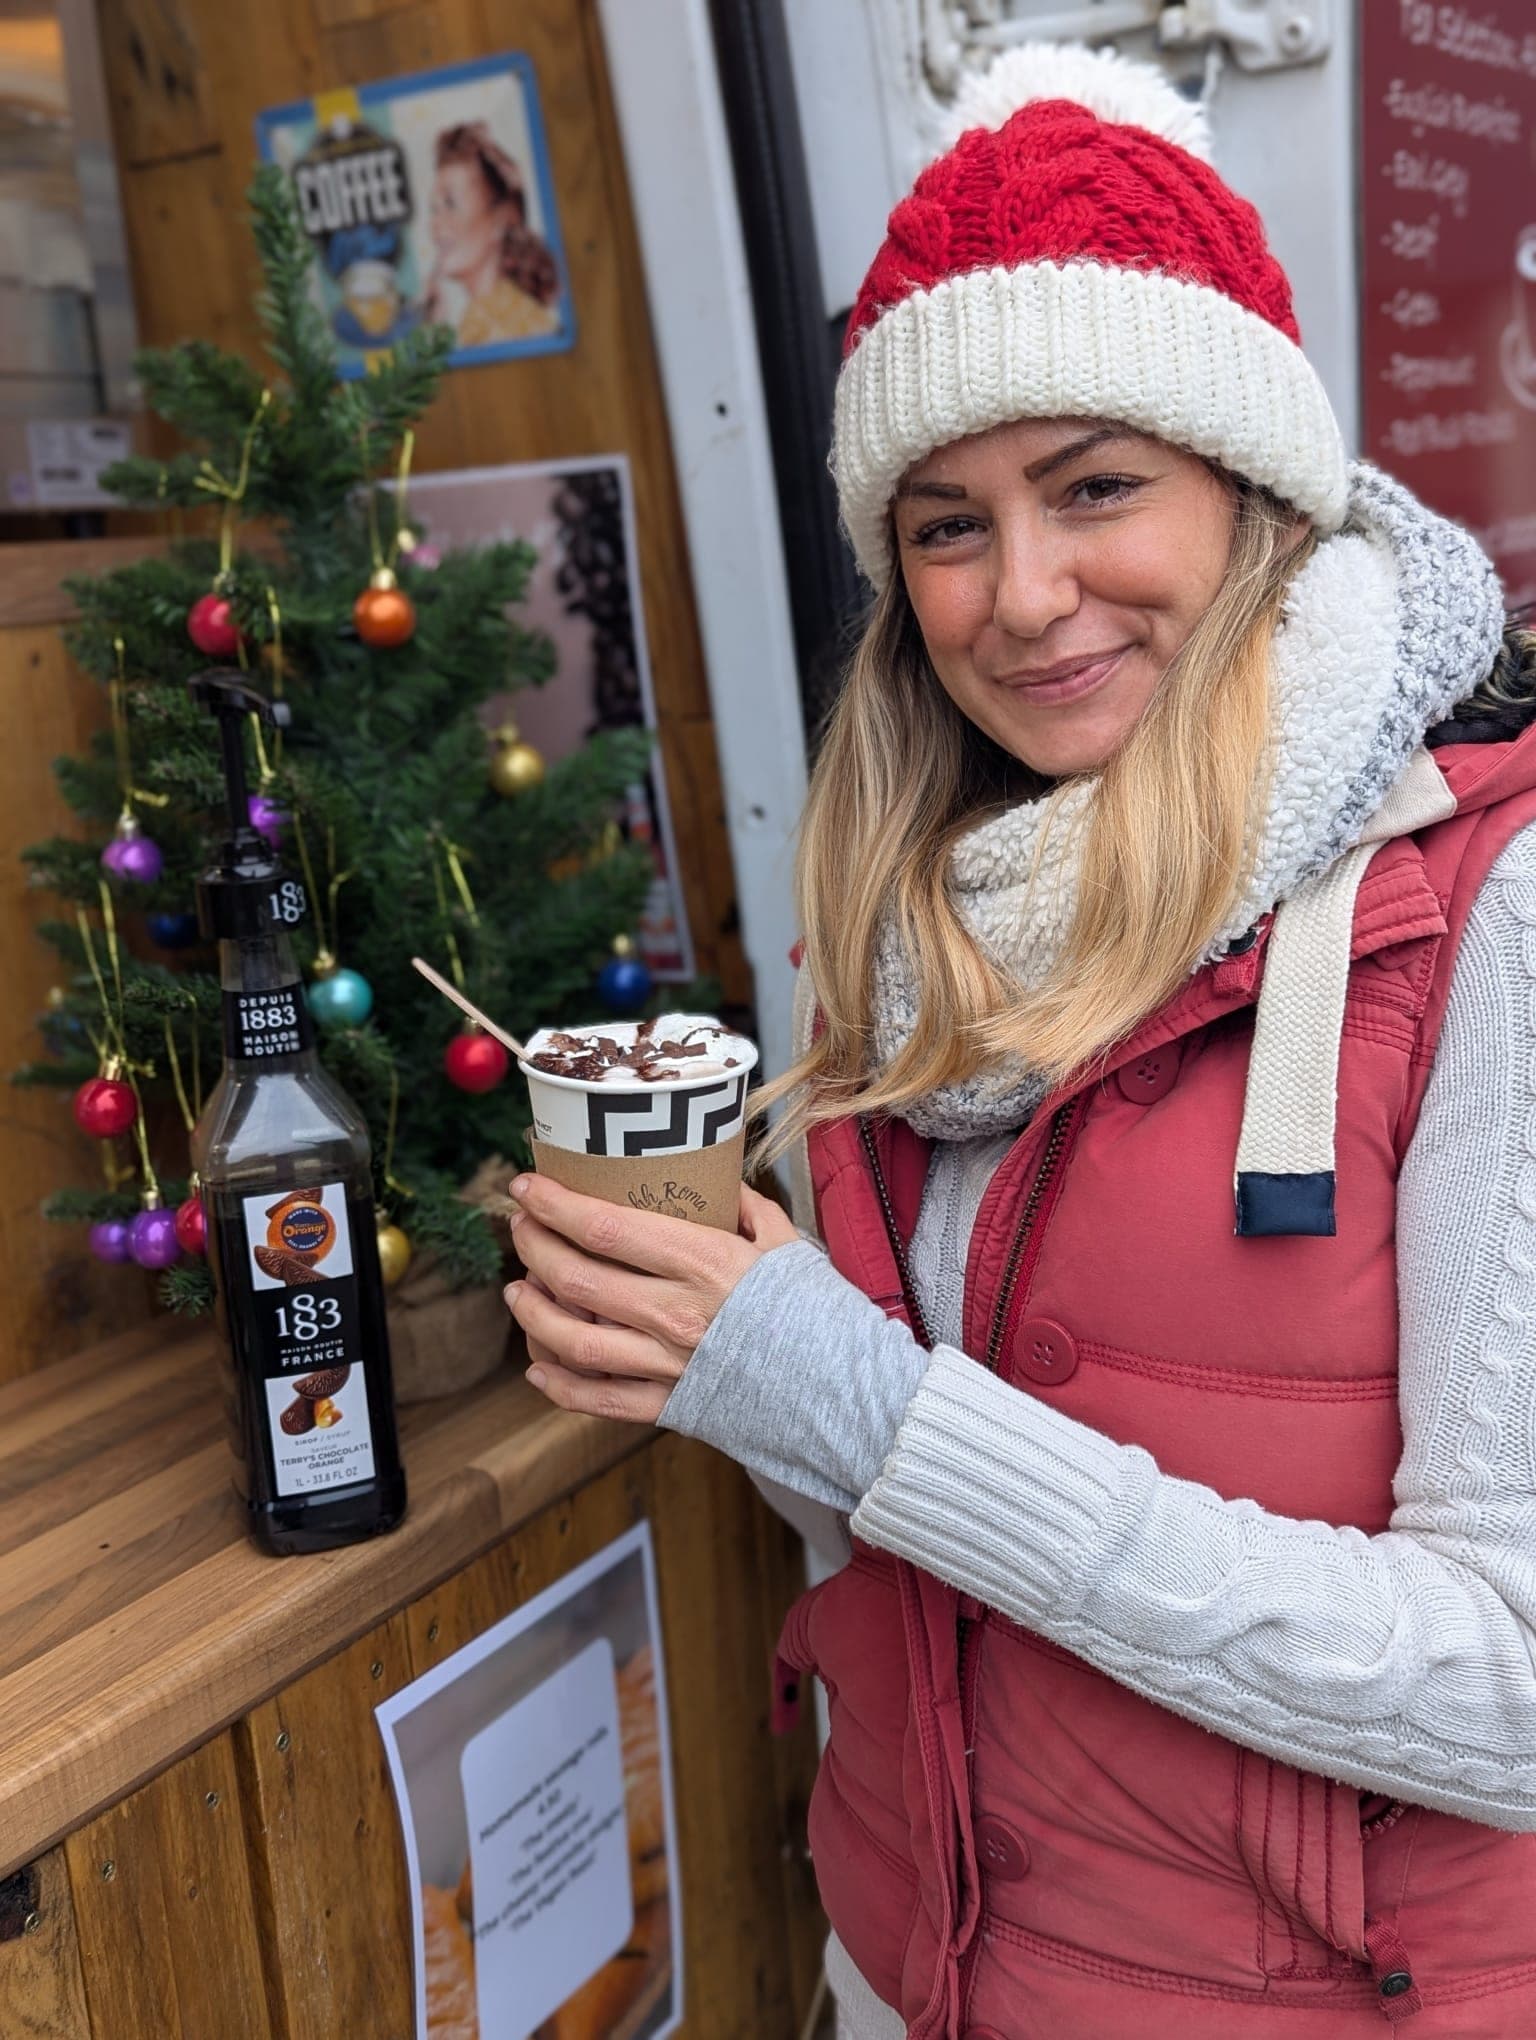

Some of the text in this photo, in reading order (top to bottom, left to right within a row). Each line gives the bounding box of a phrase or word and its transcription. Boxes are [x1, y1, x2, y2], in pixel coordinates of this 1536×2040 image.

[297, 149, 404, 233] COFFEE
[239, 993, 293, 1008] DEPUIS
[241, 1005, 297, 1030] 1883
[663, 1181, 708, 1212] Roma
[283, 1223, 326, 1237] Orange
[281, 1347, 344, 1367] FRANCE
[318, 1442, 369, 1460] CHOCOLATE
[308, 1456, 344, 1470] ORANGE
[333, 1470, 344, 1480] FL
[345, 1466, 358, 1477] OZ
